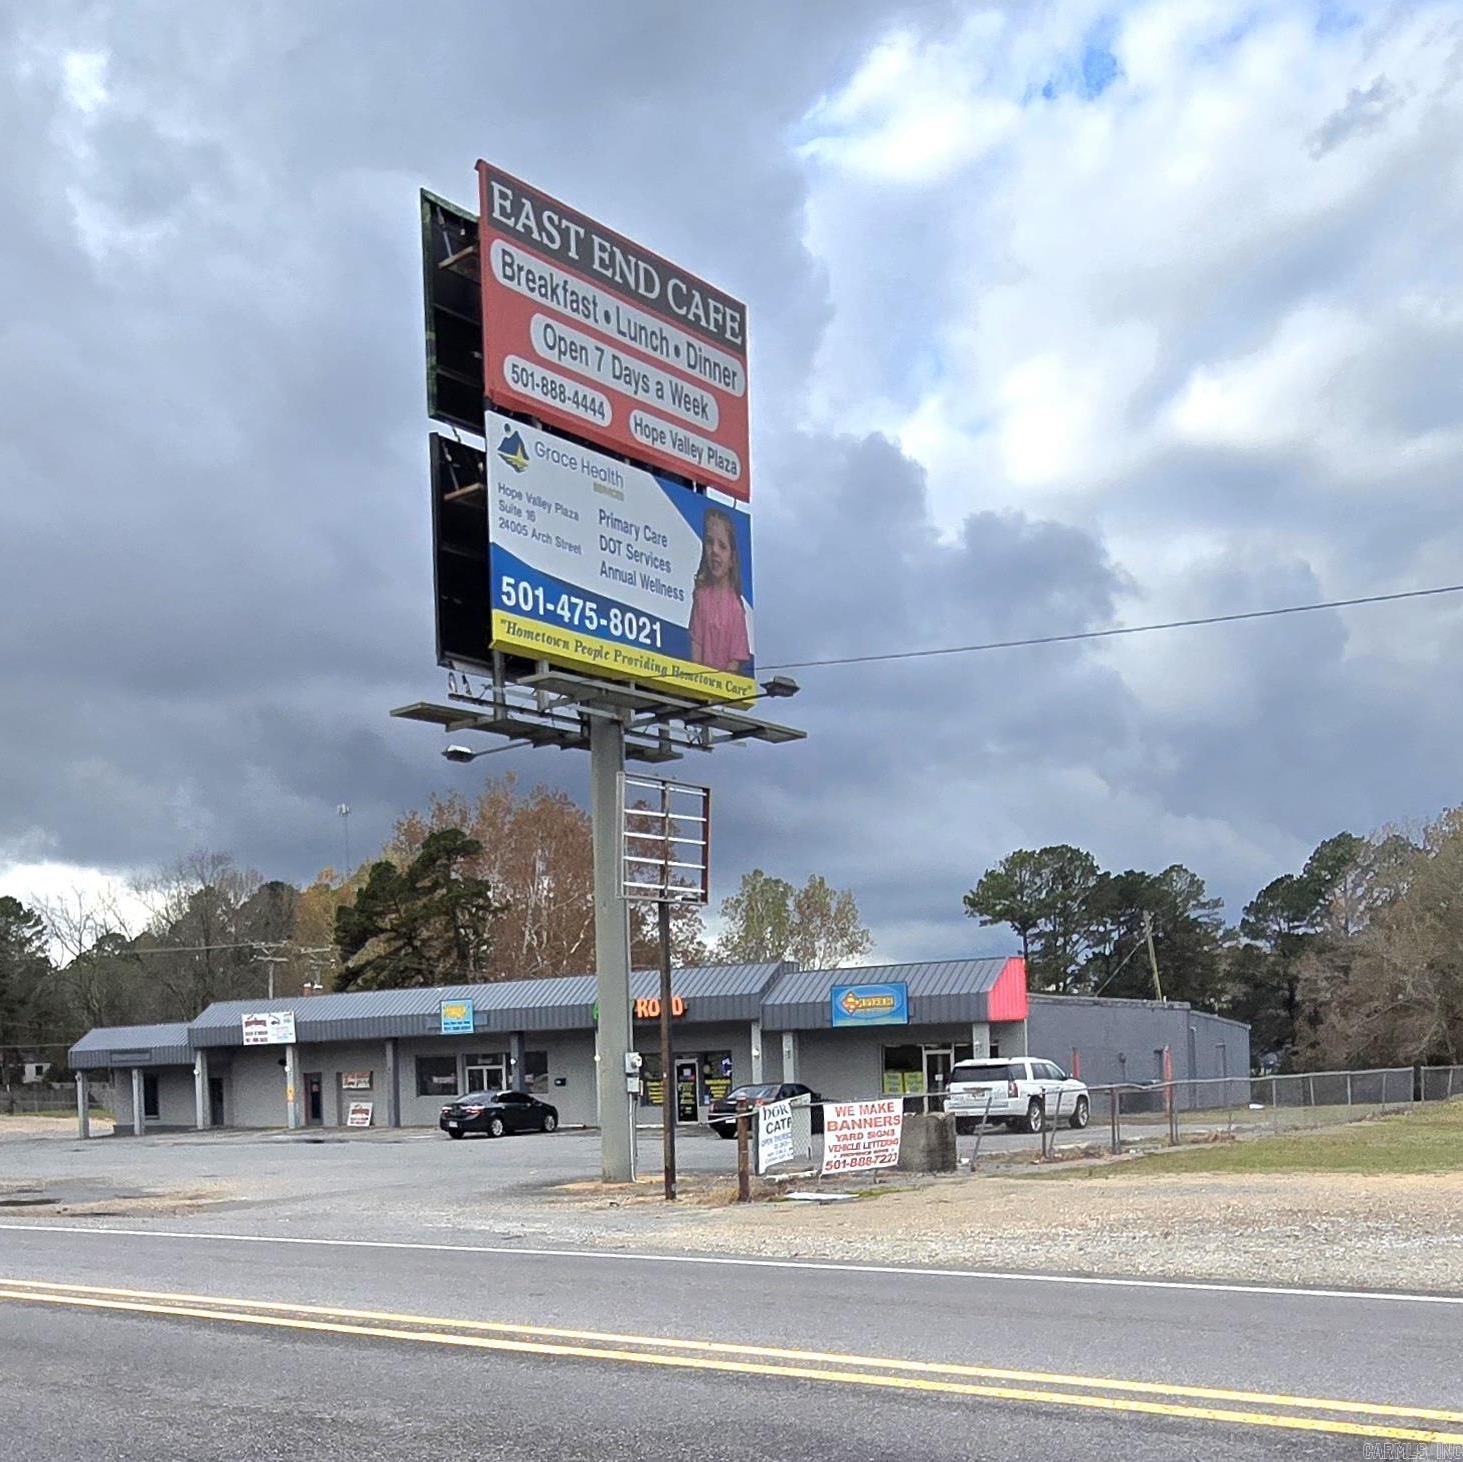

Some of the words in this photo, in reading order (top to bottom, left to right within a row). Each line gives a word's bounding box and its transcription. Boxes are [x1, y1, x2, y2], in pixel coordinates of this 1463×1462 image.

[491, 180, 585, 260] EAST
[591, 234, 661, 299] END
[667, 279, 743, 345] CAFE
[501, 248, 599, 324] Breakfast
[616, 306, 669, 358] Lunch
[686, 341, 739, 389] Dinner
[543, 322, 590, 368] Open
[595, 349, 605, 372] 7
[611, 355, 650, 399] Days
[655, 380, 665, 398] a
[668, 380, 710, 421] Week
[511, 362, 606, 421] 501-888-4444
[534, 441, 578, 471] Grace
[581, 459, 624, 487] Health
[634, 415, 667, 448] Hope
[669, 427, 704, 465] Valley
[707, 446, 738, 477] Plaza
[498, 482, 523, 500] Hope
[526, 492, 552, 514] Valley
[554, 503, 579, 521] Plaza
[499, 500, 522, 518] Suite
[499, 517, 528, 537] 24005
[531, 528, 552, 544] Arch
[555, 535, 582, 555] Street
[599, 509, 640, 543] Primary
[643, 525, 668, 548] Care
[599, 535, 622, 558] DOT
[626, 543, 672, 574] Services
[600, 560, 636, 586] Annual
[639, 572, 684, 602] Wellness
[501, 576, 662, 648] 501-475-8021
[574, 639, 610, 661] People
[614, 649, 668, 678] Providing
[671, 665, 722, 690] Hometown
[636, 997, 684, 1018] ROD
[826, 1115, 901, 1132] BANNERS
[834, 1105, 855, 1118] WE
[859, 1102, 894, 1116] MAKE
[828, 1142, 861, 1153] VEHICLE
[863, 1138, 899, 1150] LETTERING
[835, 1132, 864, 1142] YARD
[867, 1129, 895, 1139] SIGNS
[825, 1153, 898, 1171] 501-888-7223
